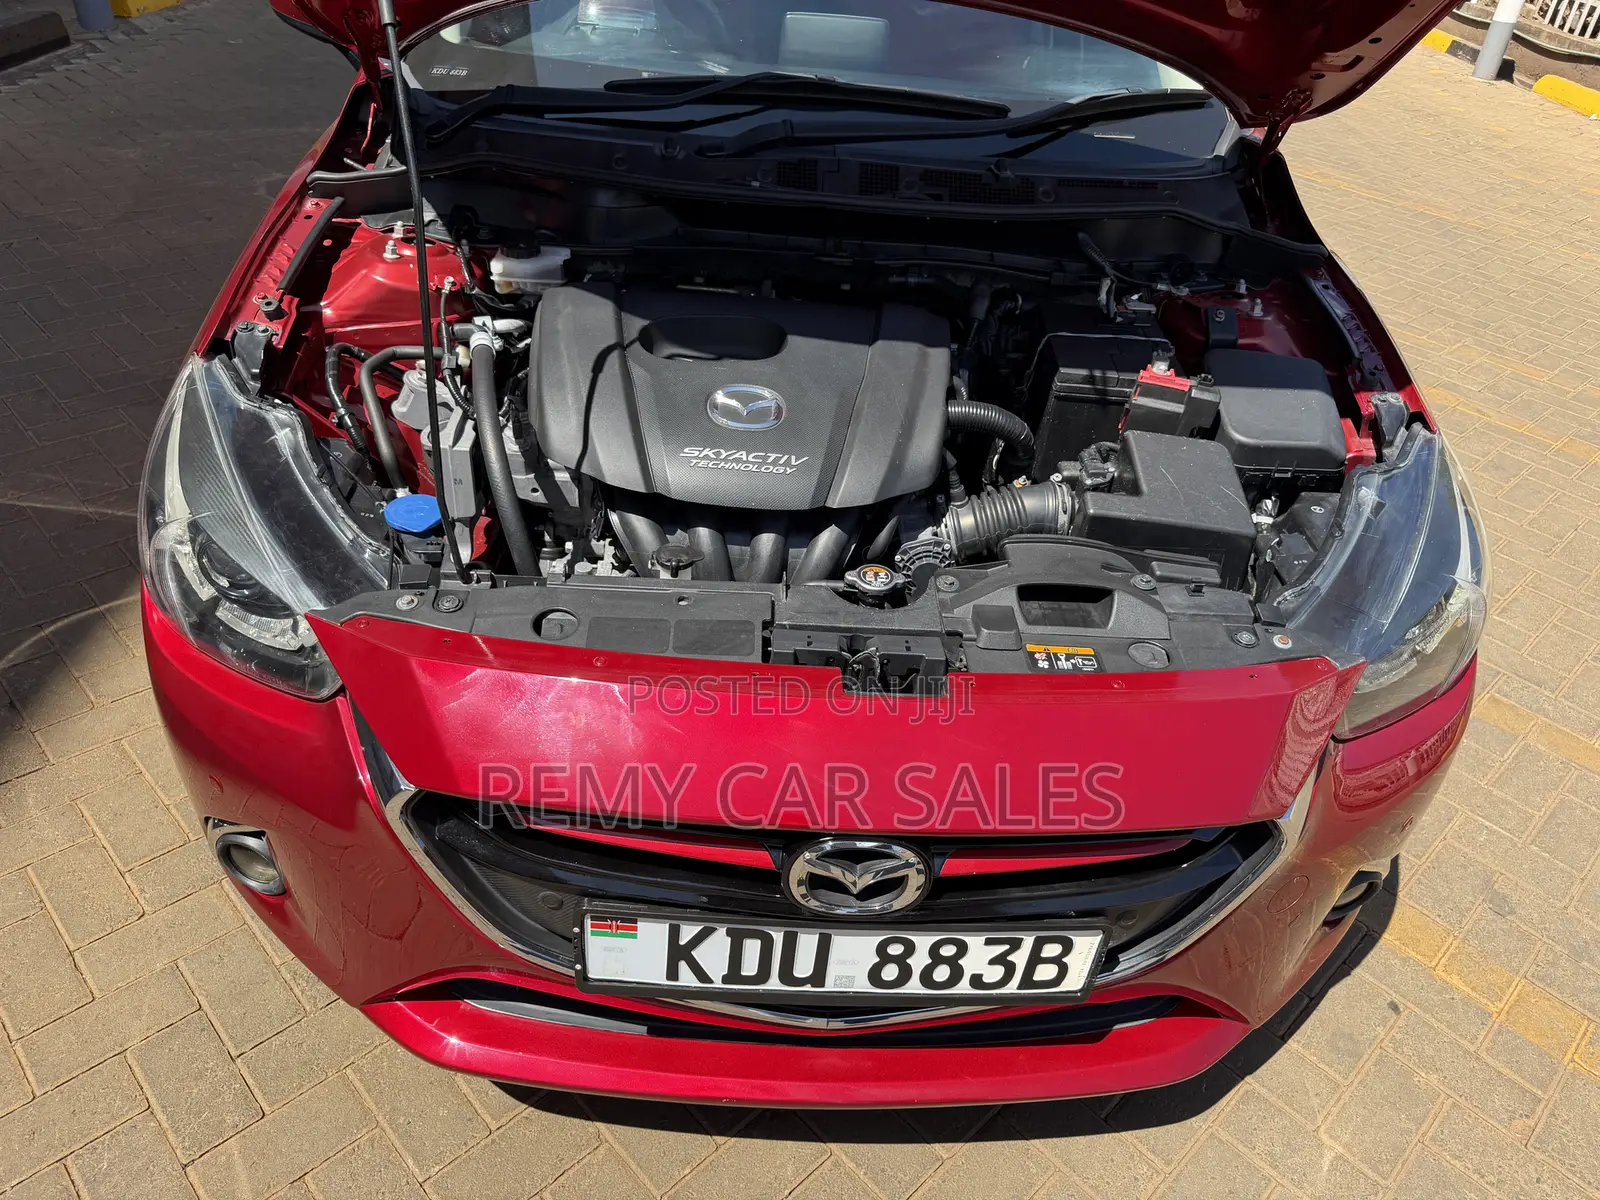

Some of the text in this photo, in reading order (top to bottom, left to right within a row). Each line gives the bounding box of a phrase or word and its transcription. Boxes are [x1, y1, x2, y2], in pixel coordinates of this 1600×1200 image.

[431, 67, 449, 75] KDU
[680, 447, 809, 466] SKYACTIV
[690, 459, 797, 475] TECHNOLOGY
[665, 922, 834, 989] KDU
[867, 934, 1075, 991] 883B
